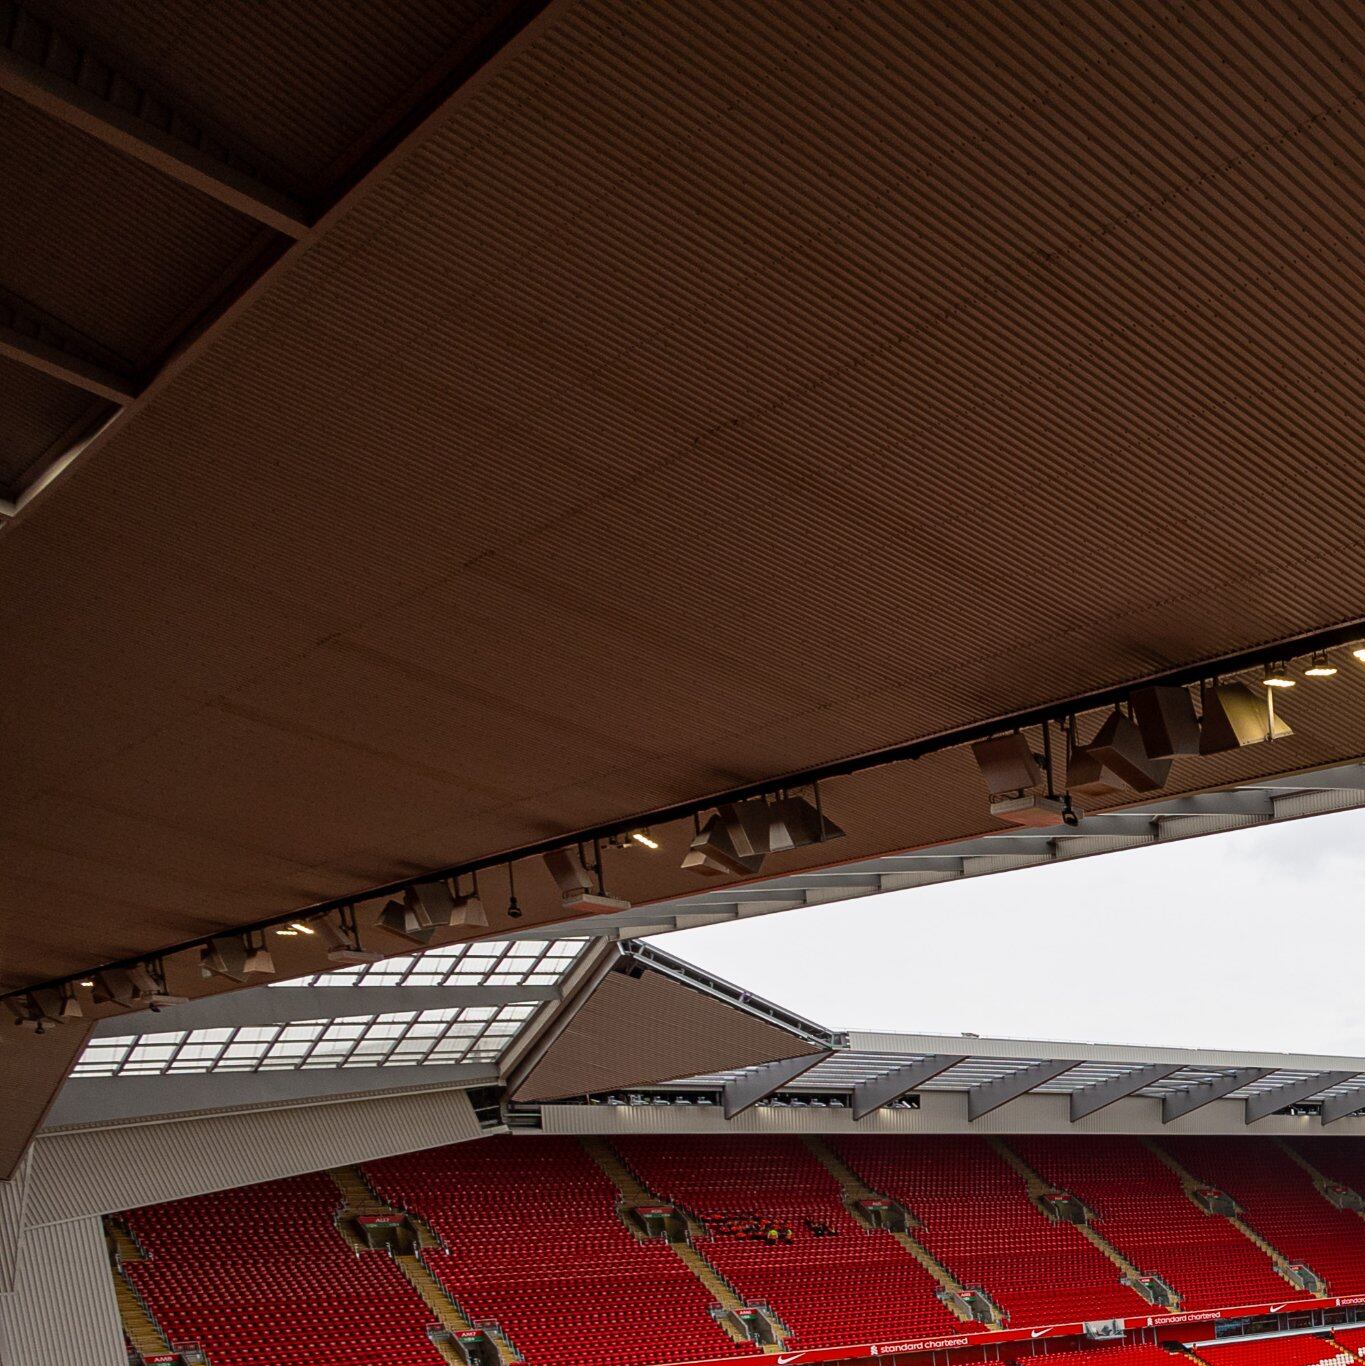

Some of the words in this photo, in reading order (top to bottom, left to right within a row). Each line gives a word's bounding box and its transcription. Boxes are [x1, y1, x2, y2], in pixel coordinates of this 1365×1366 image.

[1154, 1315, 1187, 1325] standard
[1188, 1311, 1221, 1322] chartered
[880, 1342, 922, 1354] standard
[924, 1337, 968, 1349] chartered
